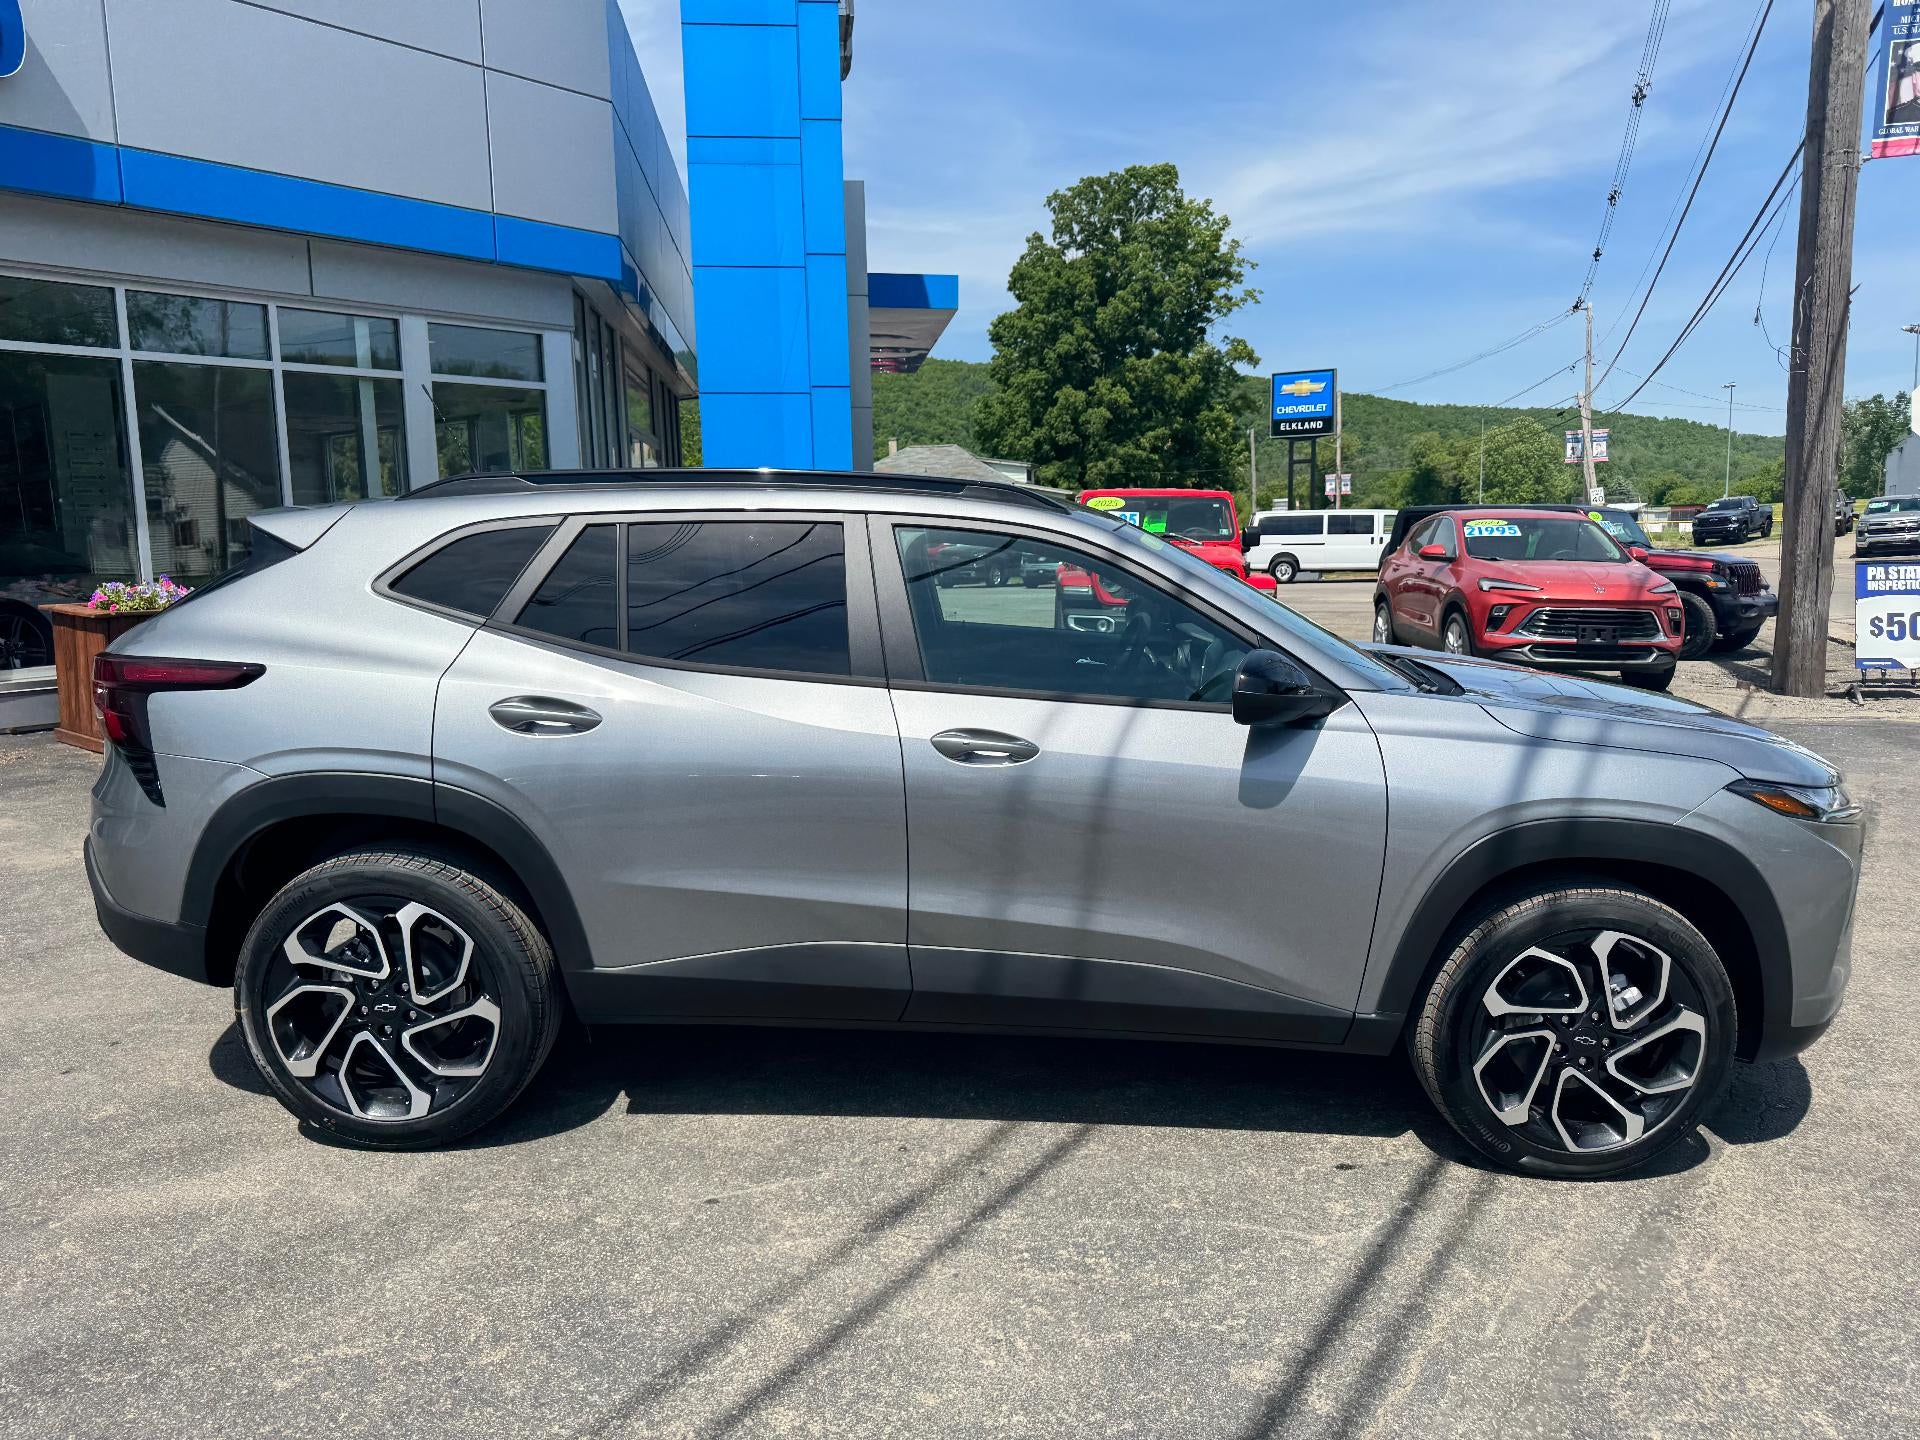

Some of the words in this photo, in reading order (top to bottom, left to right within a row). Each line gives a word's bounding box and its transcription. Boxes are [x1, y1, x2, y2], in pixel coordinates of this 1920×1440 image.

[1878, 127, 1904, 135] GLOBAL
[1276, 403, 1328, 415] CHEVROLET
[1280, 420, 1323, 431] ELKLAND
[1466, 526, 1517, 536] 21995
[1867, 566, 1886, 581] PA
